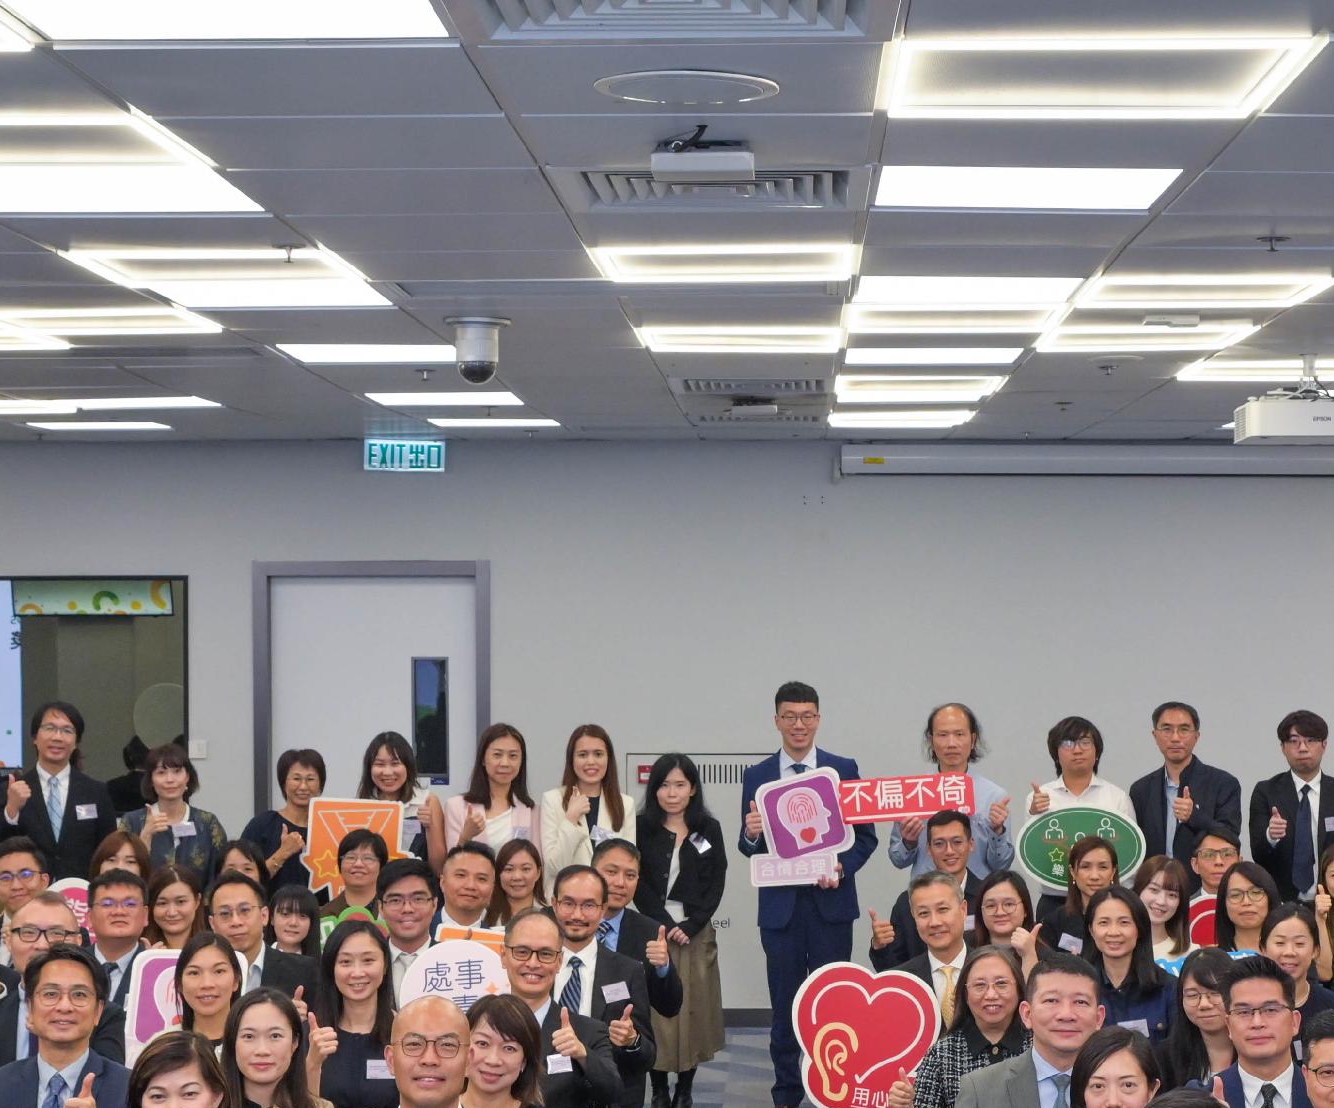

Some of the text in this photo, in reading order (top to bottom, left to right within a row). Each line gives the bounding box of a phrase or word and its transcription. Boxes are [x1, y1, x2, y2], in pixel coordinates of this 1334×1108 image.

[368, 443, 442, 468] EXIT 出口
[842, 775, 967, 813] 不偏不倚
[760, 858, 828, 878] 合情合理
[422, 959, 485, 992] 處事
